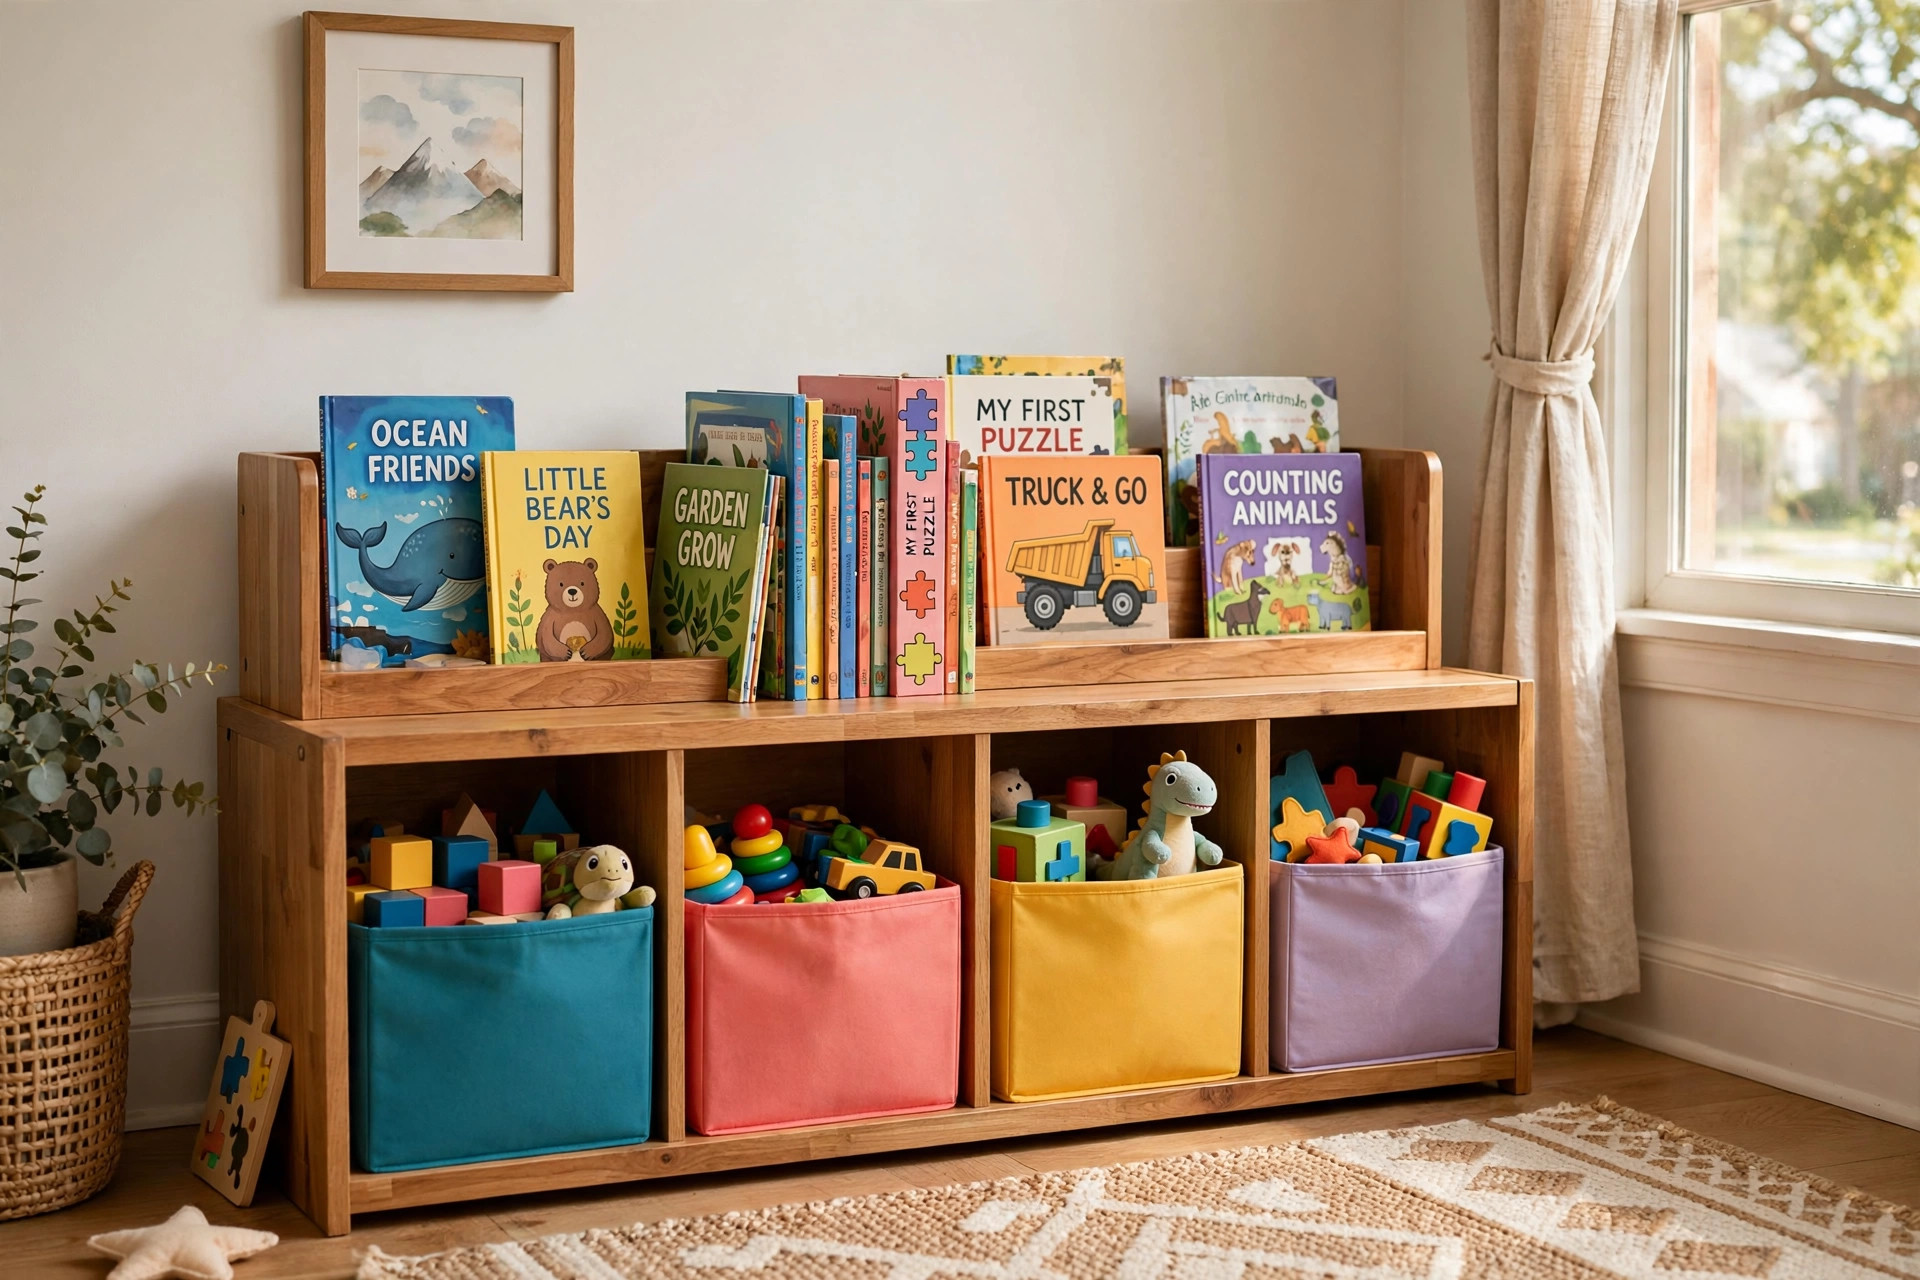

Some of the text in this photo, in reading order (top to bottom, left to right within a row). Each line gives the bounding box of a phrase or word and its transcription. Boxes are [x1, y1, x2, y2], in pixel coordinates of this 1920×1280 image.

[977, 399, 1085, 422] MY FIRST
[371, 419, 467, 447] OCEAN
[981, 428, 1083, 452] PUZZLE
[368, 454, 476, 483] FRIENDS
[524, 467, 607, 491] LITTLE
[1223, 469, 1343, 496] COUNTING
[1005, 476, 1147, 506] TRUCK & GO
[526, 495, 611, 520] BEAR'S
[674, 487, 750, 528] GARDEN
[1232, 498, 1338, 526] ANIMALS
[544, 525, 593, 549] DAY
[905, 491, 917, 556] MY FIRST
[922, 496, 935, 556] PUZZLE
[677, 529, 736, 570] GROW
